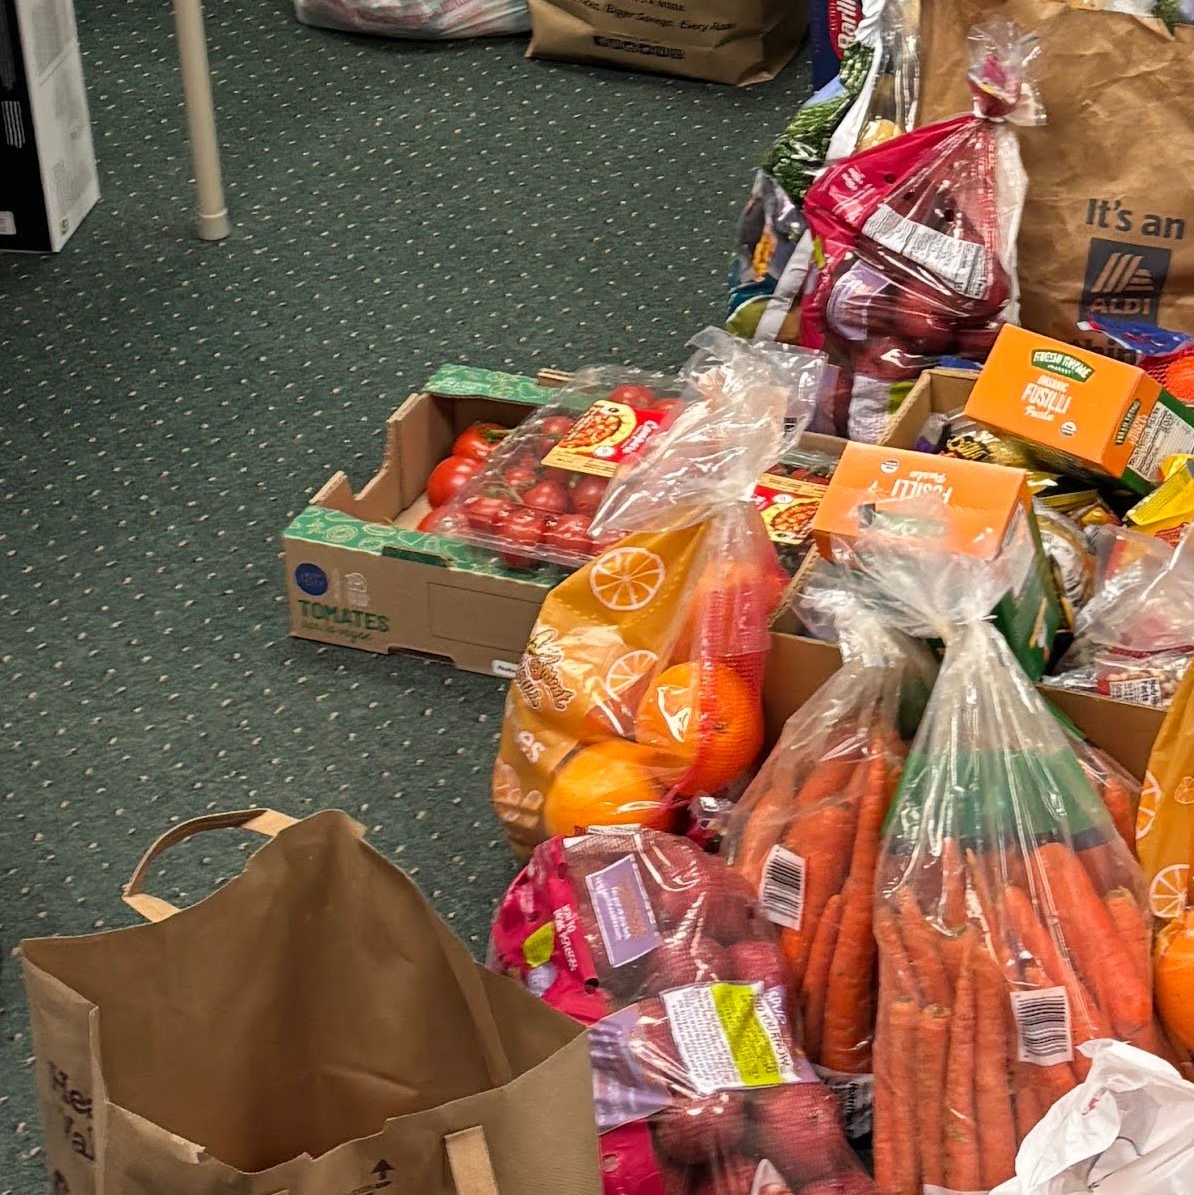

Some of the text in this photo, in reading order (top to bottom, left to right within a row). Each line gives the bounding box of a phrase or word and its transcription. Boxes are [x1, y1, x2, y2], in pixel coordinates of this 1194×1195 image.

[1141, 212, 1186, 240] an
[1089, 293, 1154, 317] ALDI
[1020, 382, 1073, 415] FUSILLI
